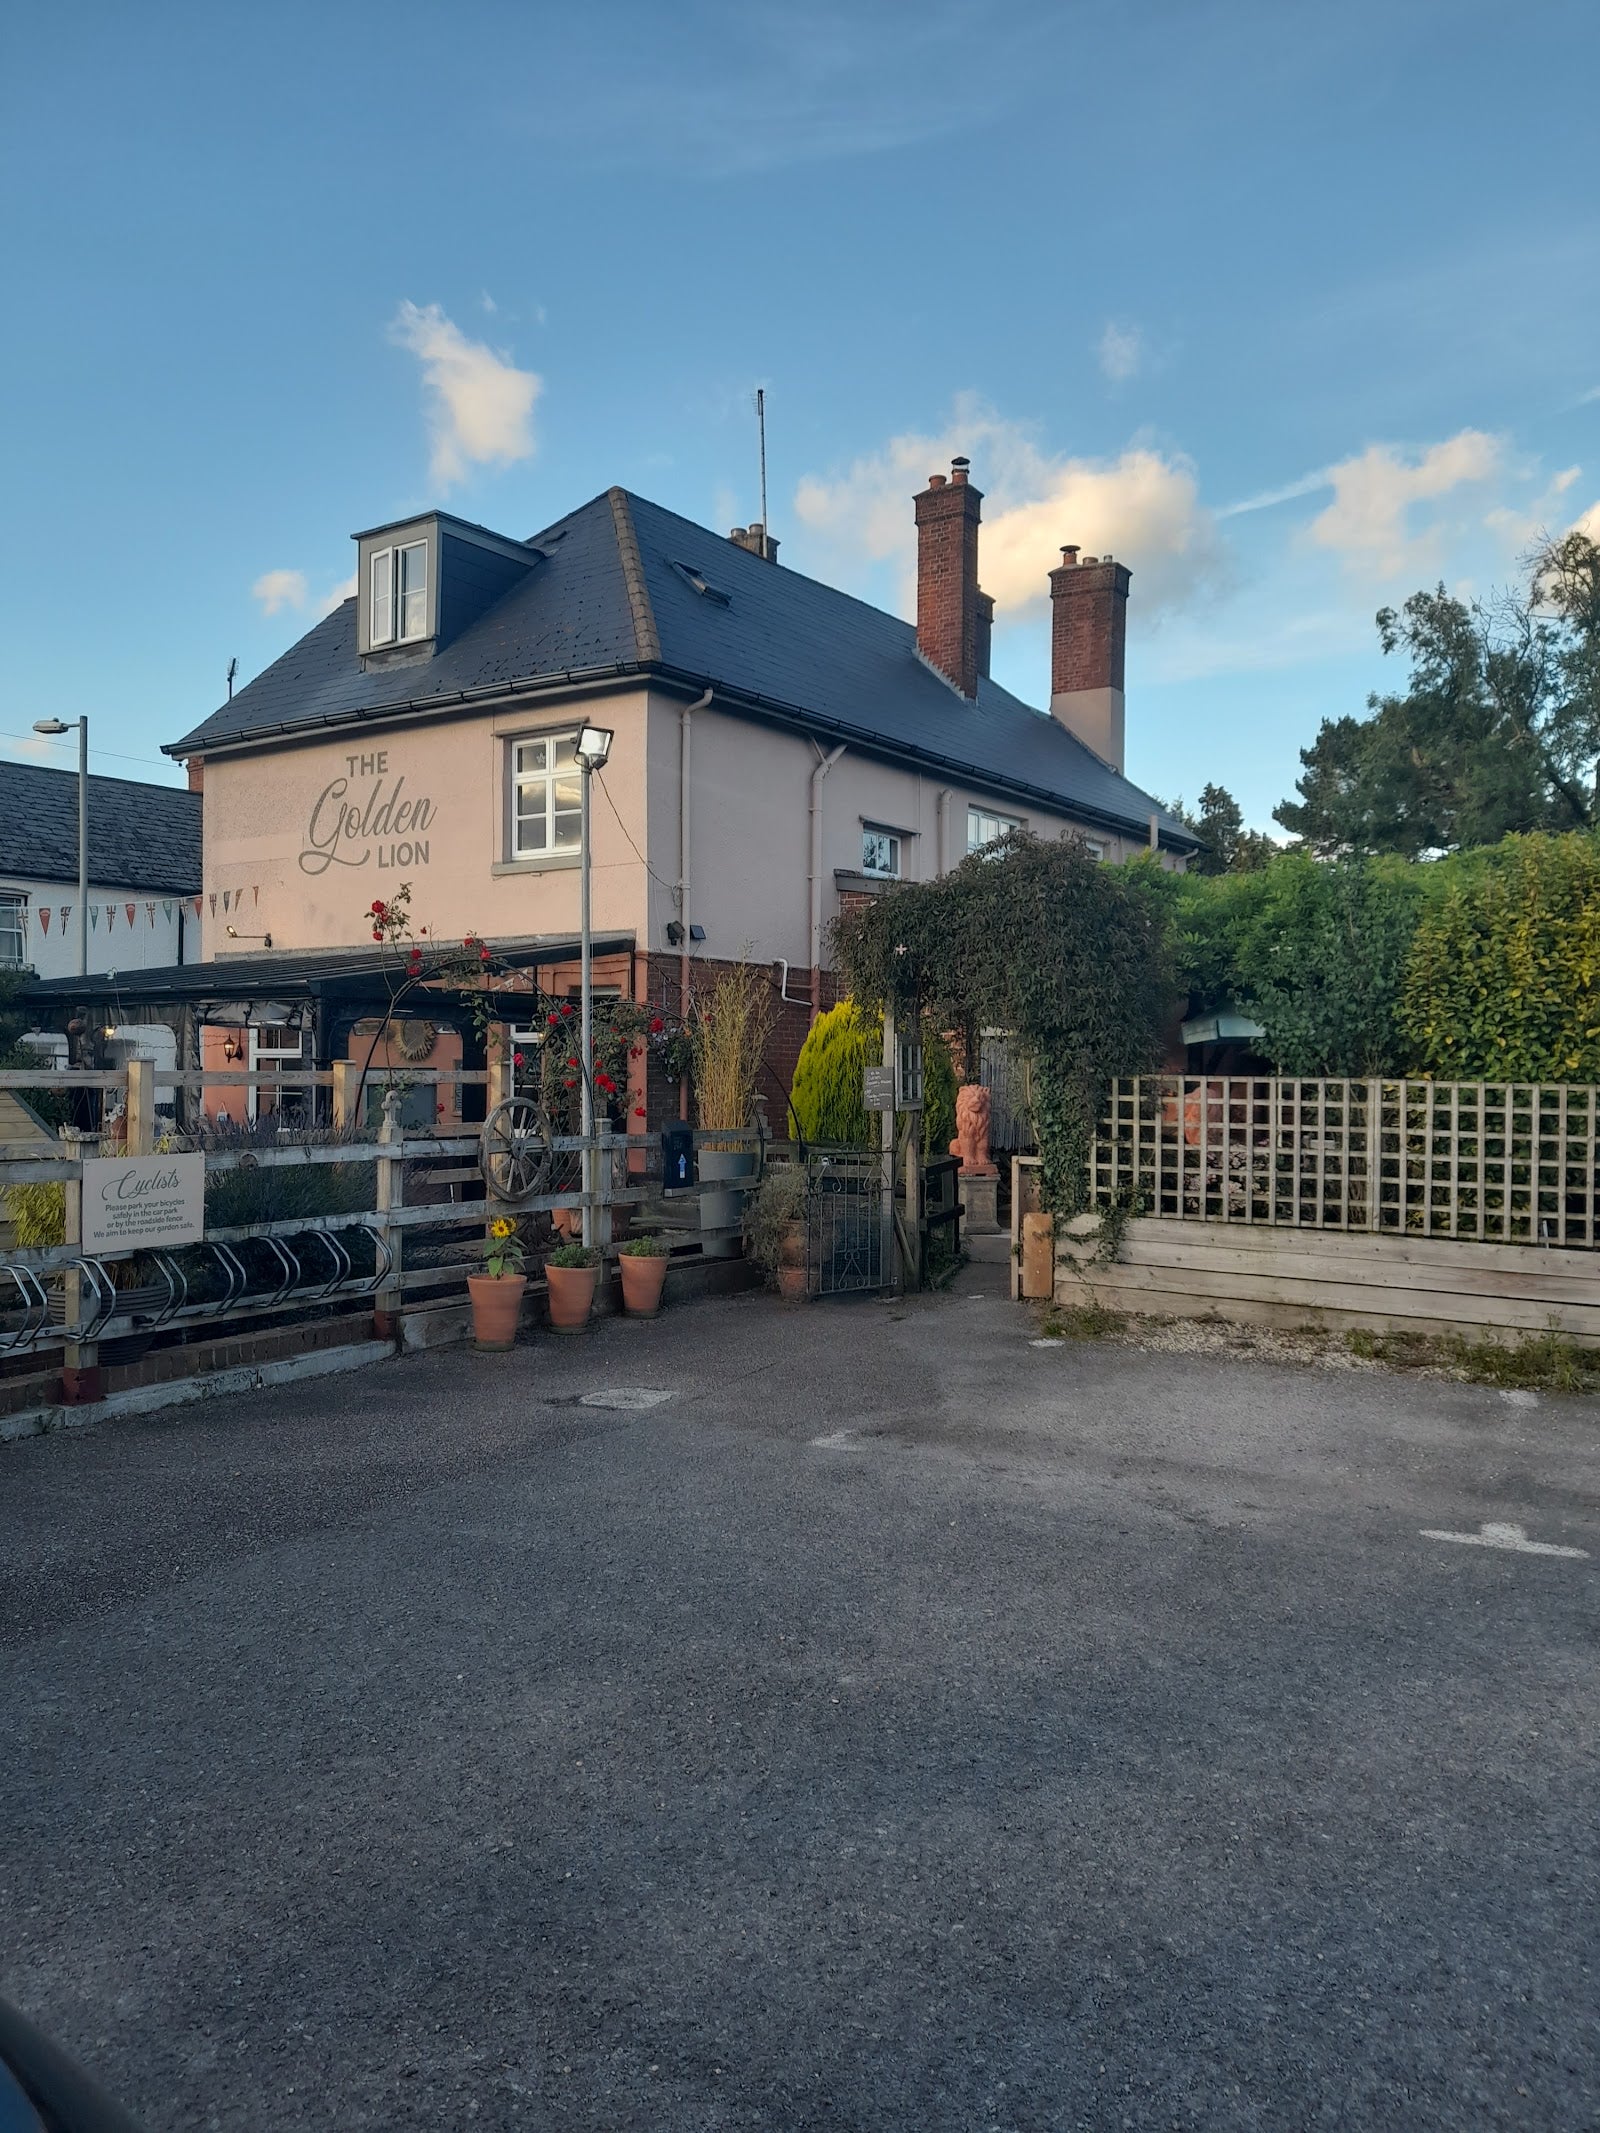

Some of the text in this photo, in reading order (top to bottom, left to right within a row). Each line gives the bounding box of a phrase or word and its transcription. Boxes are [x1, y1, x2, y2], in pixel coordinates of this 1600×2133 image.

[346, 751, 389, 777] THE
[298, 776, 437, 875] Golden
[378, 840, 430, 868] LION
[101, 1168, 180, 1200] Cyclists
[112, 1211, 132, 1220] safely
[163, 1207, 178, 1216] park
[128, 1202, 143, 1210] park
[143, 1202, 159, 1211] your
[160, 1199, 185, 1207] bicycles
[115, 1221, 124, 1229] by
[137, 1217, 165, 1225] roadside
[127, 1228, 144, 1236] keep
[156, 1224, 179, 1233] garden
[179, 1221, 195, 1229] safe.
